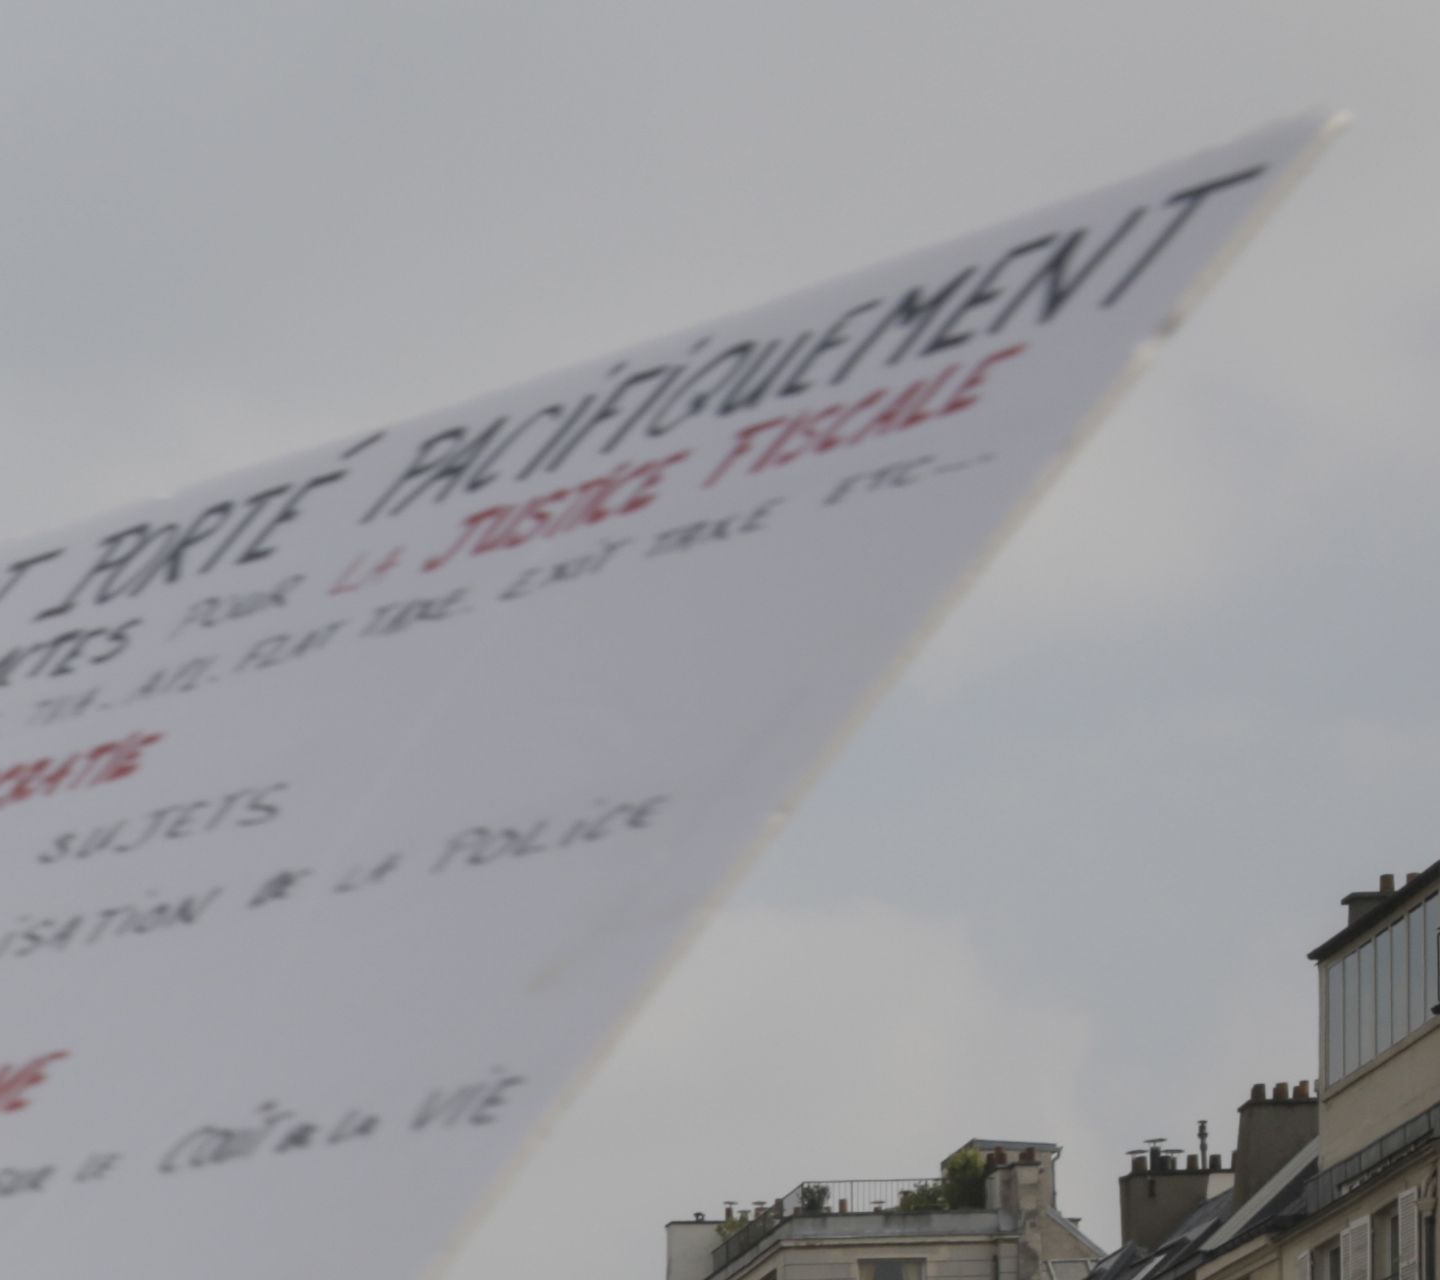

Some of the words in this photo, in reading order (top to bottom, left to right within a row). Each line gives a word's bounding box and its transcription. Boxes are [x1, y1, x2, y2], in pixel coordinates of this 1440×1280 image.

[29, 430, 388, 623] PORTÉ
[167, 573, 307, 640] POUR
[327, 545, 406, 596] LA
[36, 783, 289, 864] SUJETS
[332, 852, 405, 894] LA
